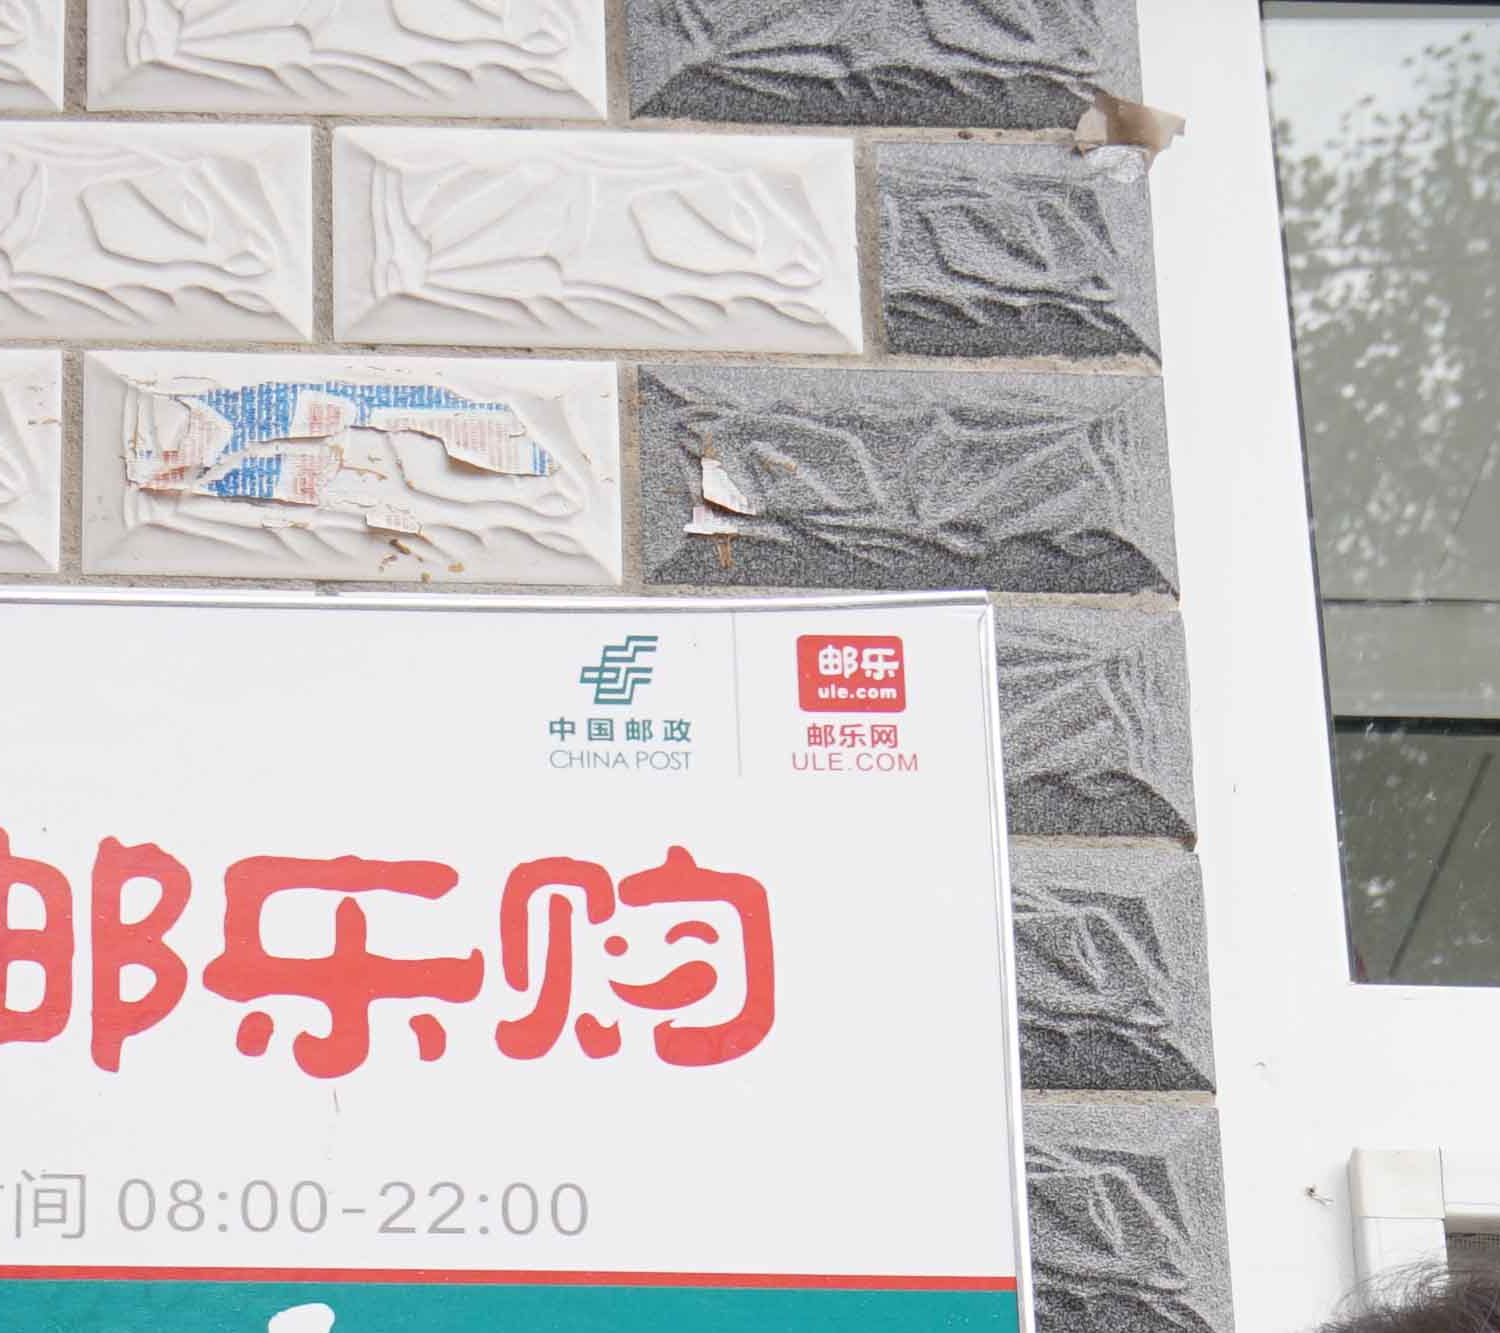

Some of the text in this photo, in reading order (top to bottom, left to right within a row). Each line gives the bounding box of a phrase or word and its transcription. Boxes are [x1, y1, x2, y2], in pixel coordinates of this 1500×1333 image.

[818, 644, 899, 680] 邮乐
[818, 684, 897, 700] ule.com
[549, 717, 692, 743] 中国邮政
[807, 723, 898, 748] 邮乐网
[549, 749, 692, 770] CHINA POST
[791, 752, 919, 772] ULE.COM
[116, 1178, 590, 1238] 08:00-22:00
